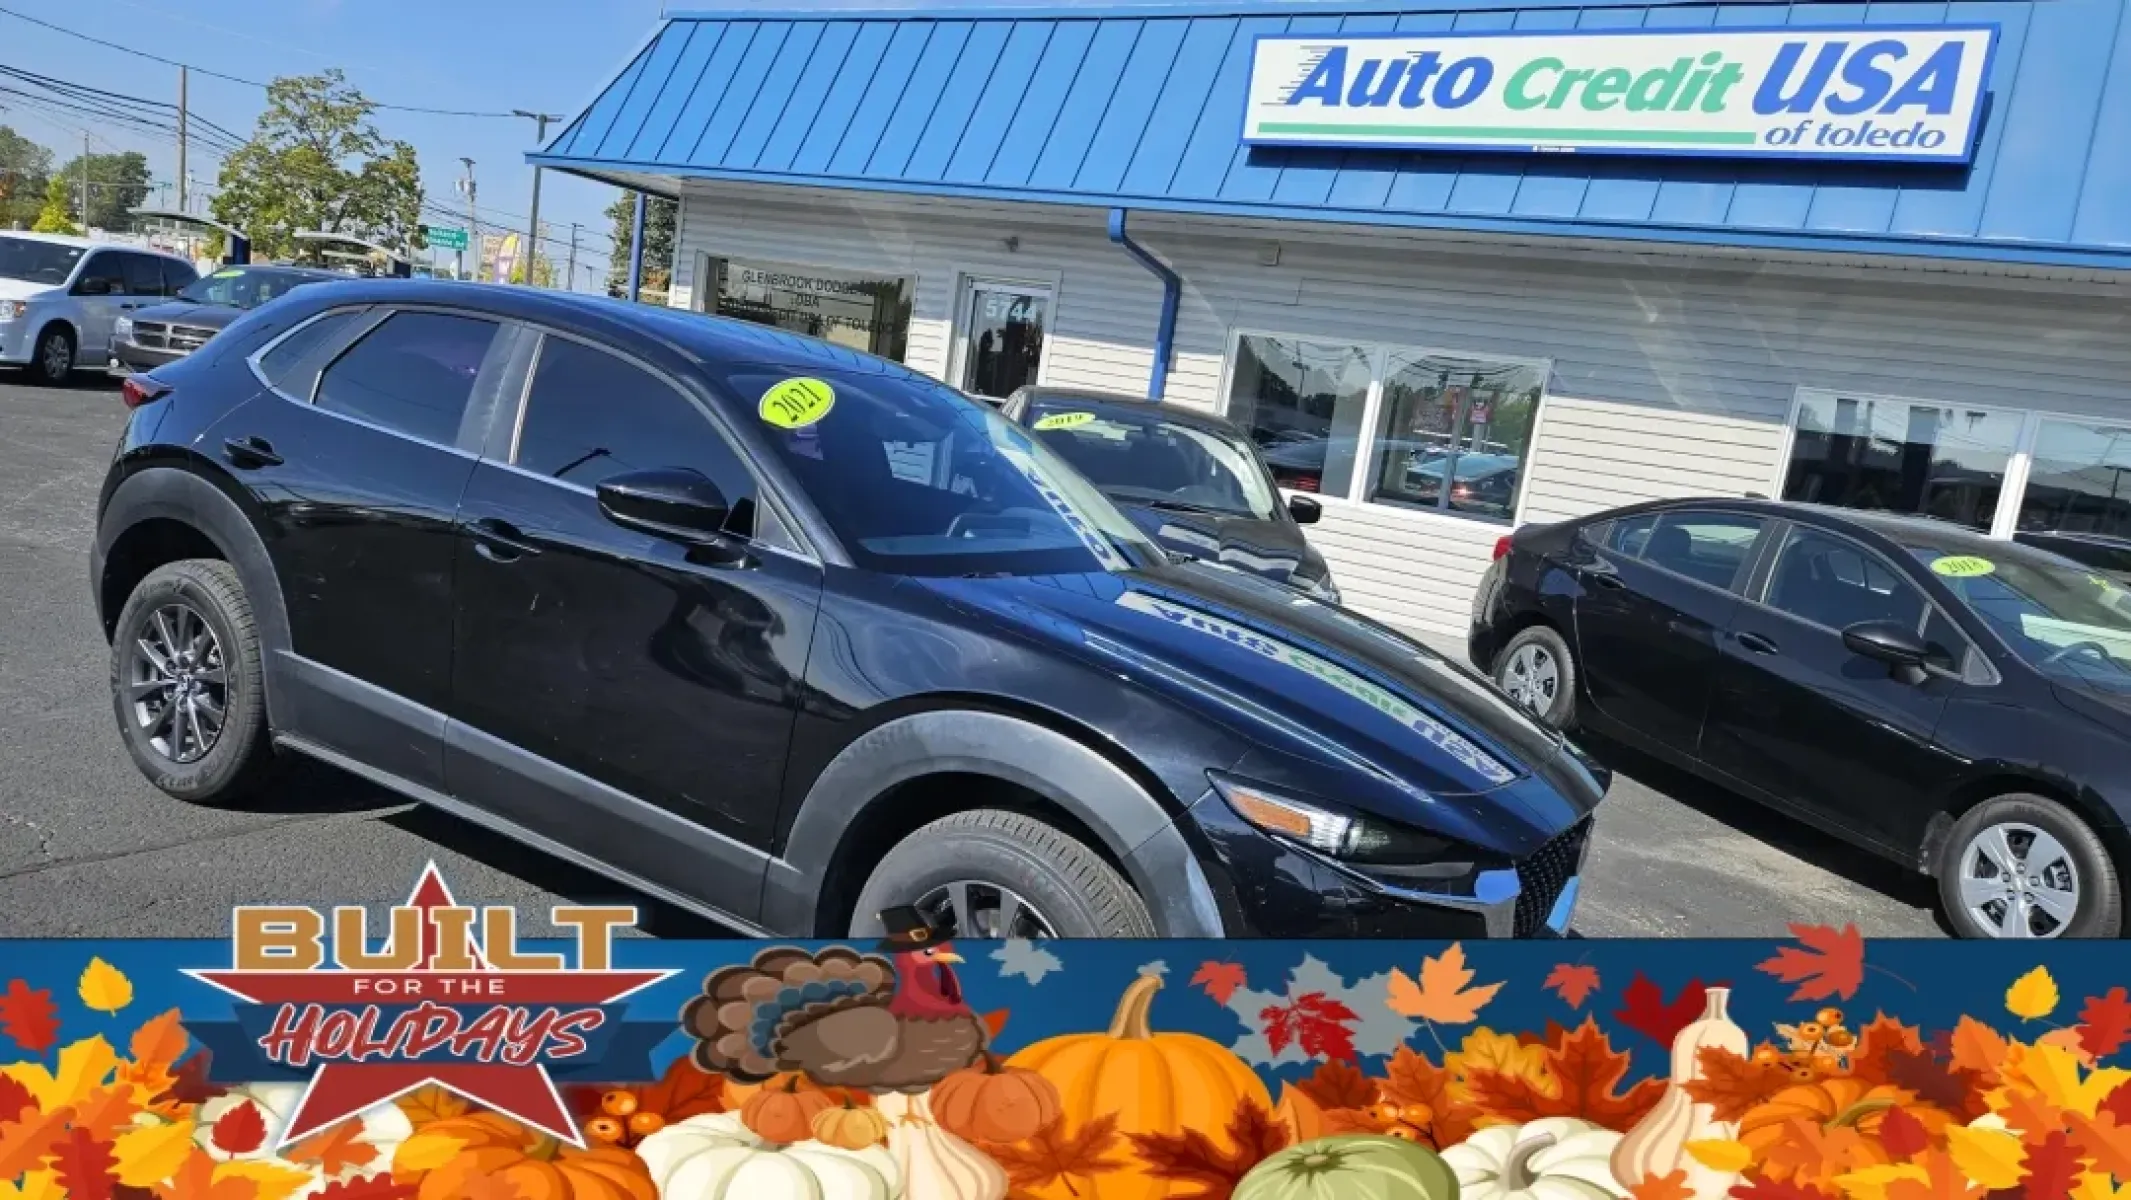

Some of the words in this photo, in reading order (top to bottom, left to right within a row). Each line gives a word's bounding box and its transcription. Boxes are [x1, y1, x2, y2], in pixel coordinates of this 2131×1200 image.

[1279, 45, 1494, 110] Auto
[1502, 50, 1744, 113] Credit
[1752, 39, 1966, 115] USA
[1765, 120, 1813, 145] of
[1815, 120, 1946, 148] toledo
[742, 270, 813, 289] GLENBROOK
[986, 300, 1038, 322] 5744
[772, 381, 822, 422] 2021
